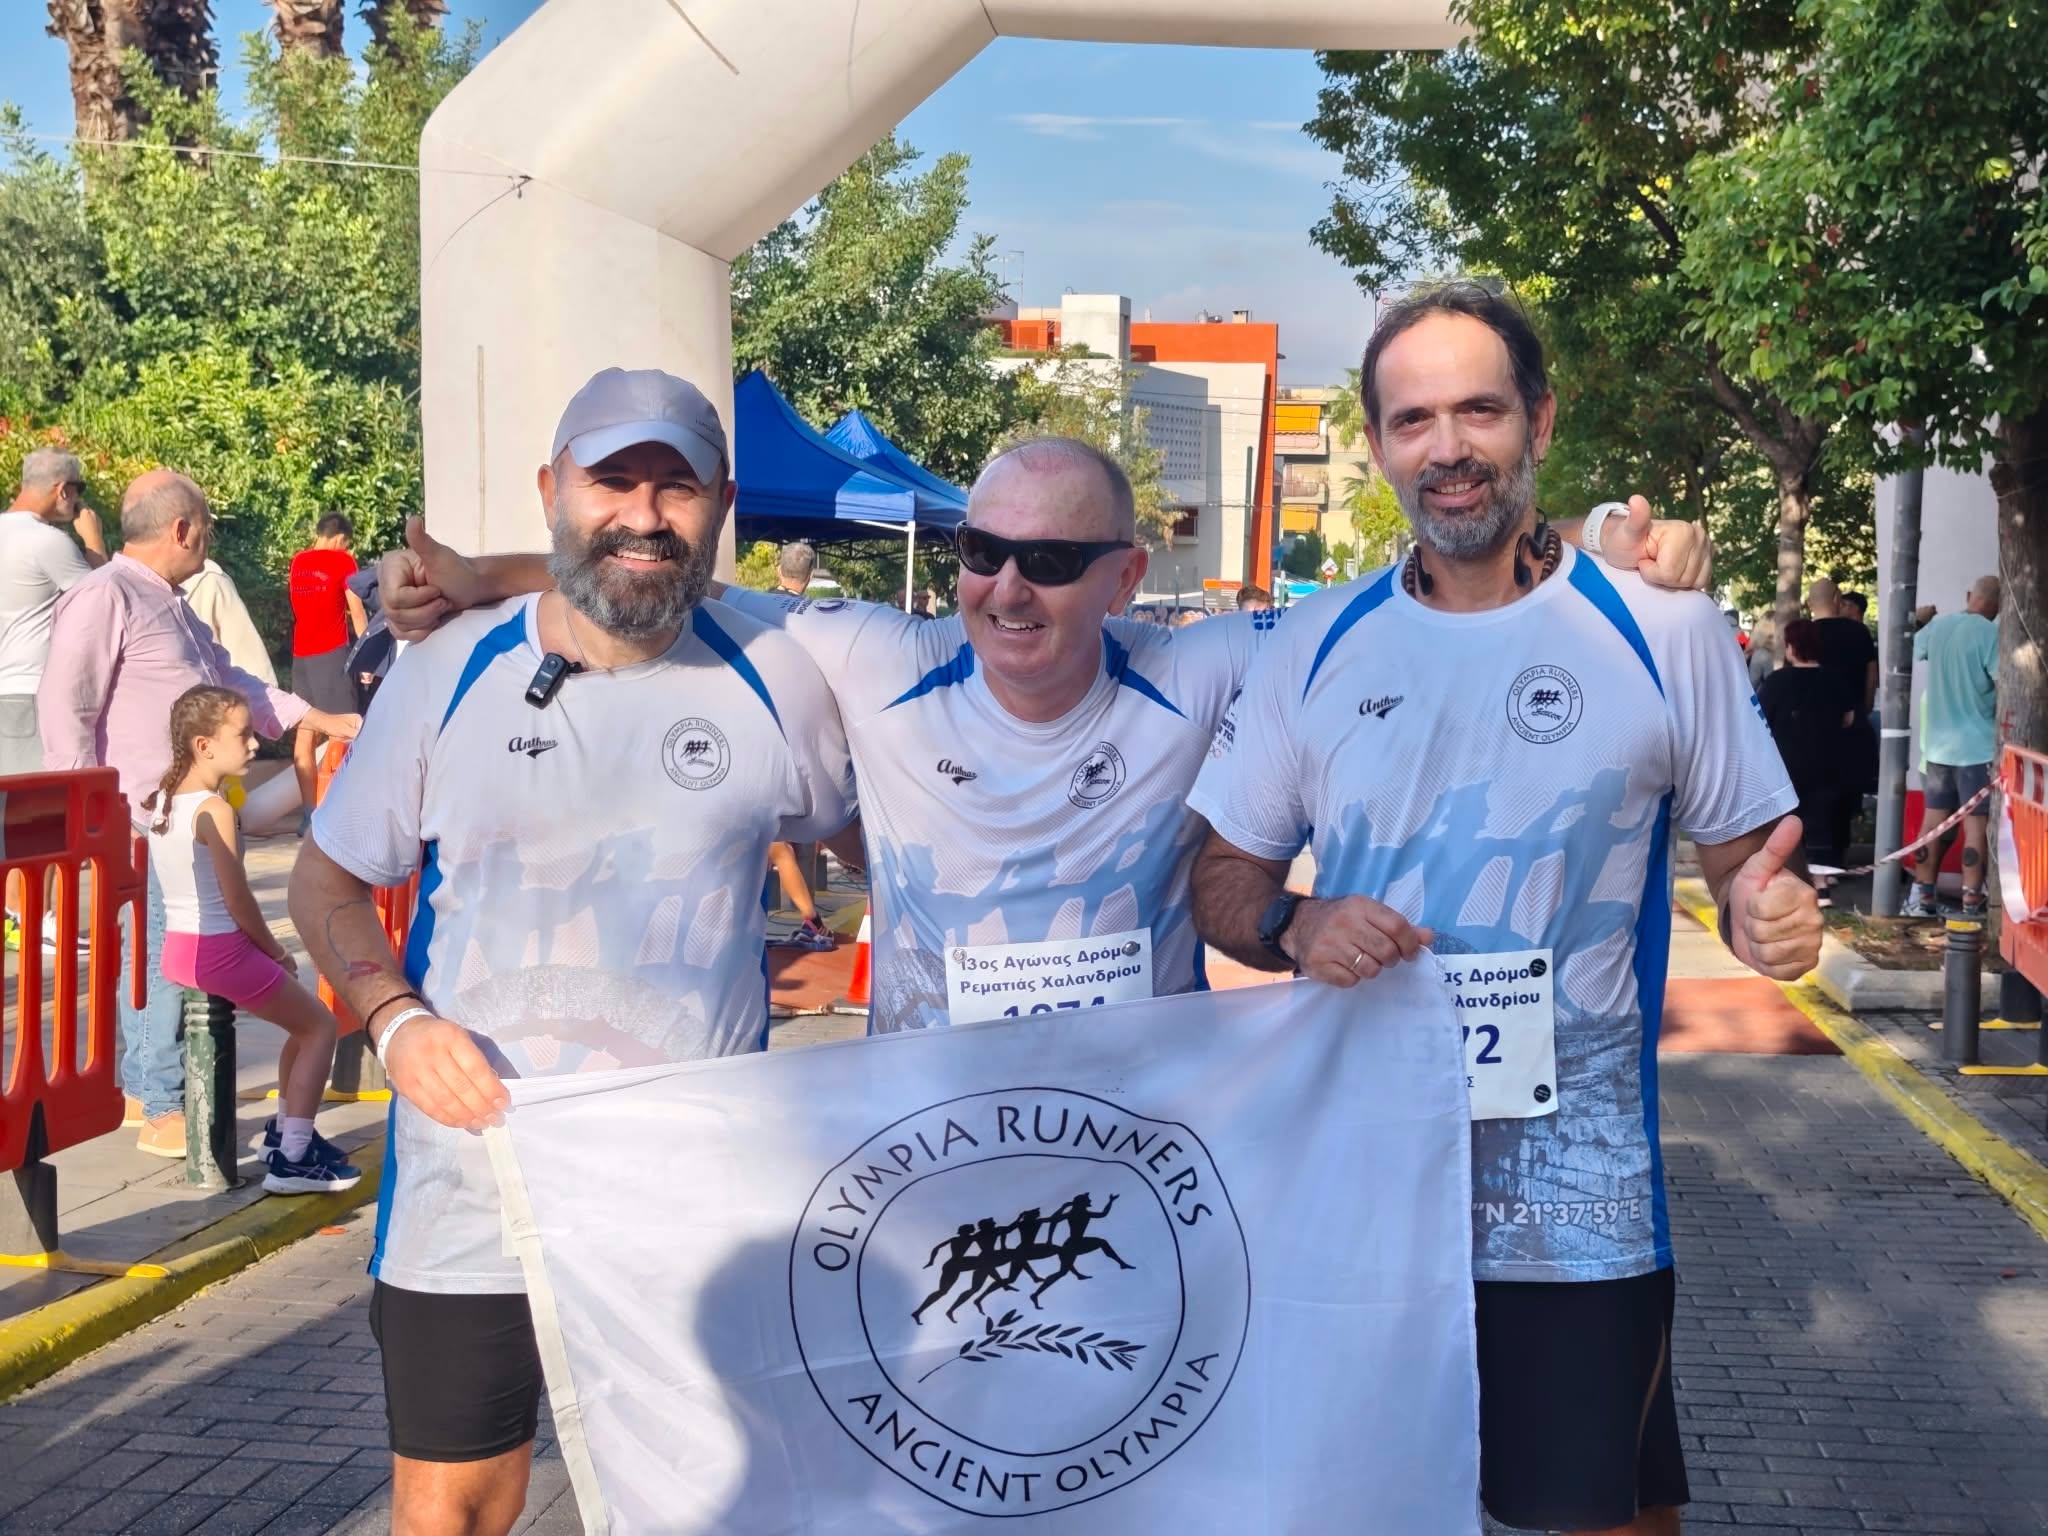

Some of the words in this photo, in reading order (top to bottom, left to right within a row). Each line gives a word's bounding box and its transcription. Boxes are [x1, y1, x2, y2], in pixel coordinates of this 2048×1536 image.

[1512, 667, 1546, 696] OLYMPIA
[1548, 667, 1579, 700] RUNNERS
[1511, 717, 1540, 741] ANCIENT
[1541, 721, 1574, 742] OLYMPIA
[961, 957, 999, 973] 13ος
[1004, 954, 1072, 971] Αγώνας
[1077, 946, 1140, 964] Δρόμ
[960, 978, 1037, 996] Ρεματιάς
[1041, 964, 1141, 989] Χαλανδρίου
[1469, 966, 1531, 986] Δρόμο
[1454, 992, 1540, 1010] λανδρίου
[813, 1118, 980, 1272] OLYMPIA
[997, 1105, 1213, 1226] RUNNERS
[847, 1392, 1042, 1502] ANCIENT
[1055, 1351, 1220, 1492] OLYMPIA
